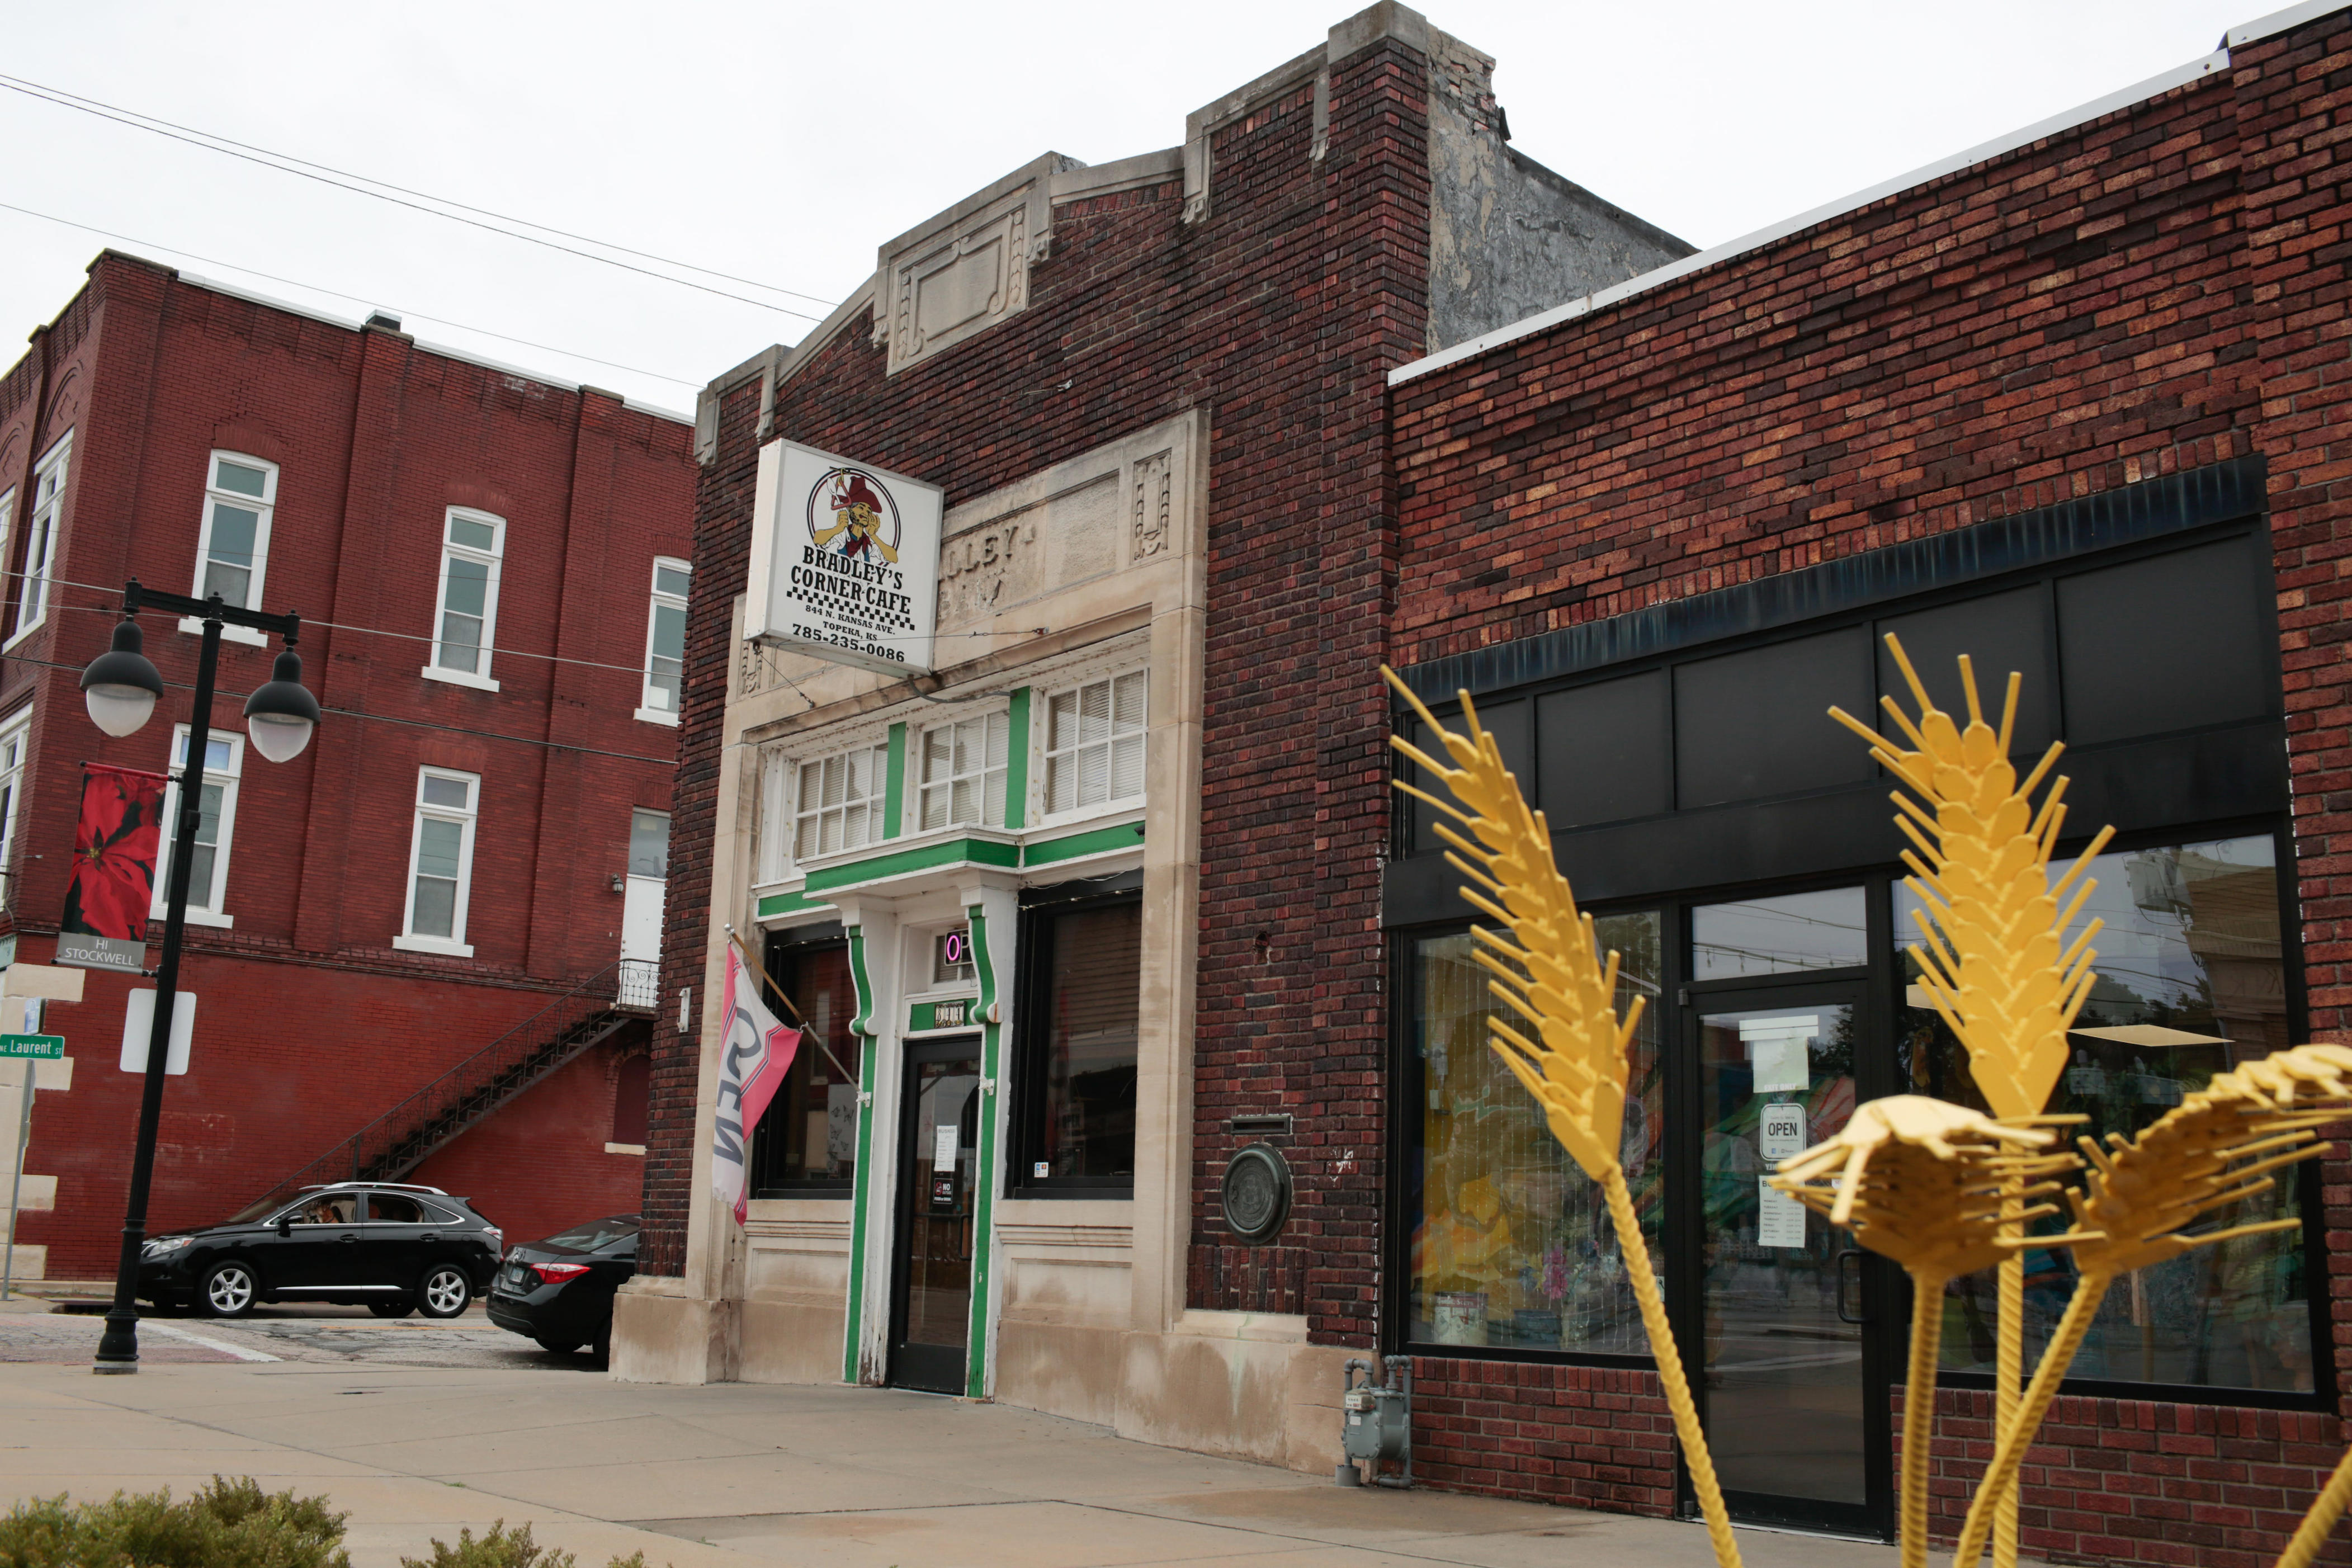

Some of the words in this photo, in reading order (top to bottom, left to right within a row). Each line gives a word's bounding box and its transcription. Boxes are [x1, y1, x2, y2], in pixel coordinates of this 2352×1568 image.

[938, 526, 1019, 583] LLEY
[802, 546, 903, 589] BRADLEY'S
[791, 565, 862, 601] CORNER
[866, 586, 911, 615] CAFE
[805, 605, 823, 615] 844
[825, 610, 835, 618] N.
[838, 613, 873, 629] KANSAS
[875, 624, 895, 635] AVE.
[823, 621, 863, 639] TOPEKA,
[866, 632, 877, 641] KS
[792, 624, 905, 662] 785-235-0086
[65, 948, 134, 966] STOCKWELL
[96, 939, 108, 950] HI
[11, 1039, 51, 1054] Laurent
[1768, 1122, 1797, 1136] OPEN
